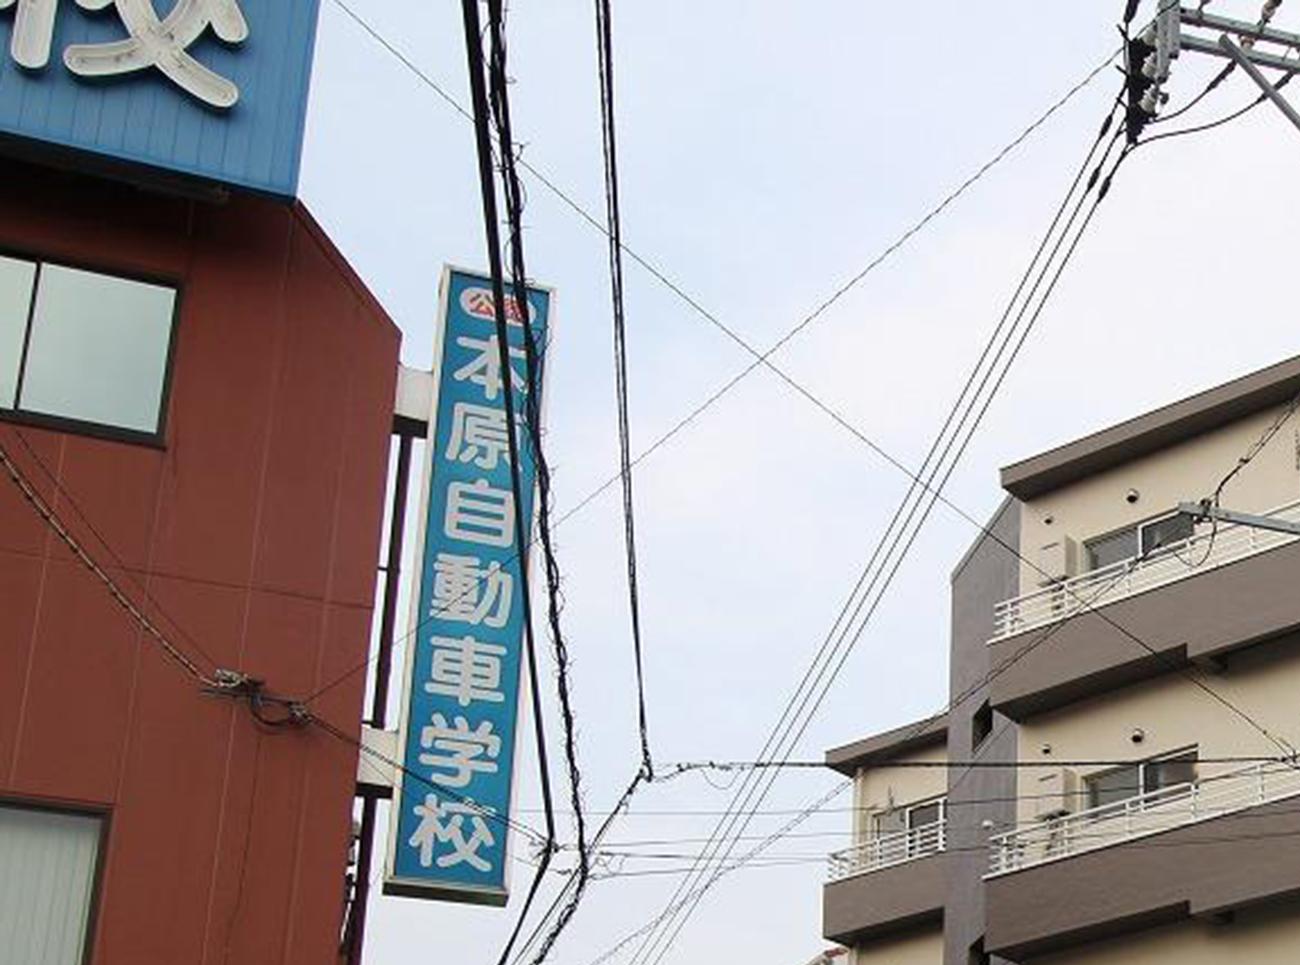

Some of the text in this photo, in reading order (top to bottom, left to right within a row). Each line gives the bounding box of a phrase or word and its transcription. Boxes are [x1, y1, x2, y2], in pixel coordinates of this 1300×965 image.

[409, 334, 528, 873] 本原自動車学校
